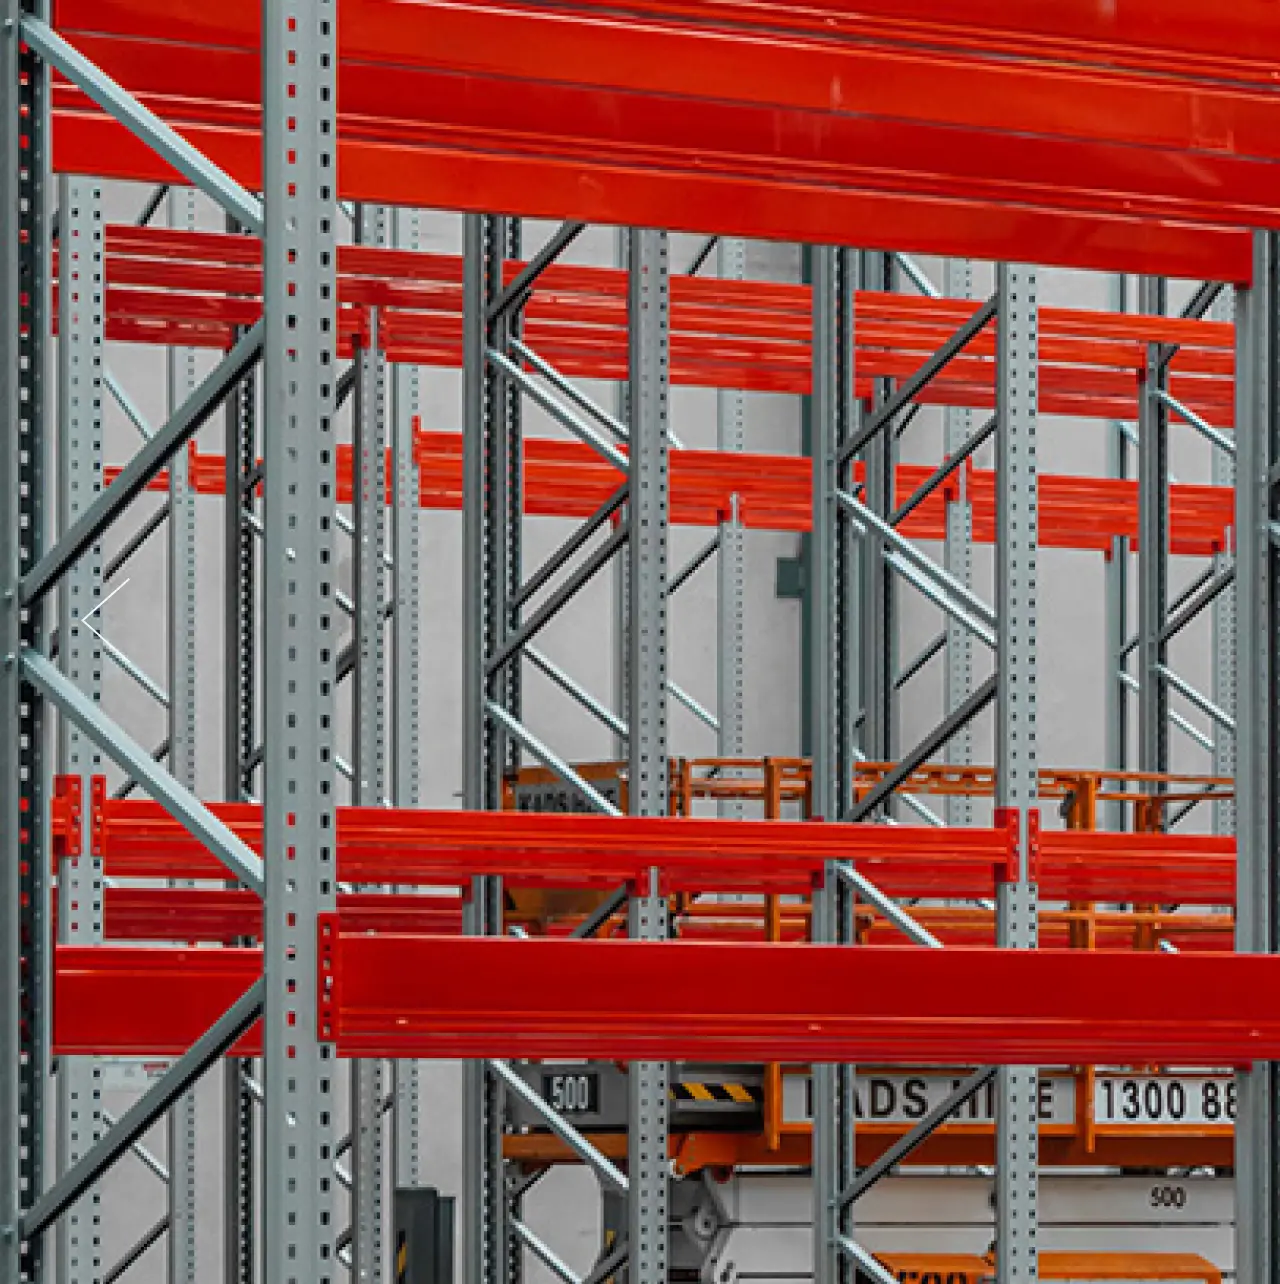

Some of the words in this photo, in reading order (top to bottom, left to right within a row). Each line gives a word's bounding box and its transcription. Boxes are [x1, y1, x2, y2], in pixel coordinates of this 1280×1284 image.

[552, 1075, 589, 1110] 500
[1101, 1080, 1187, 1120] 1300
[1150, 1187, 1187, 1209] 500
